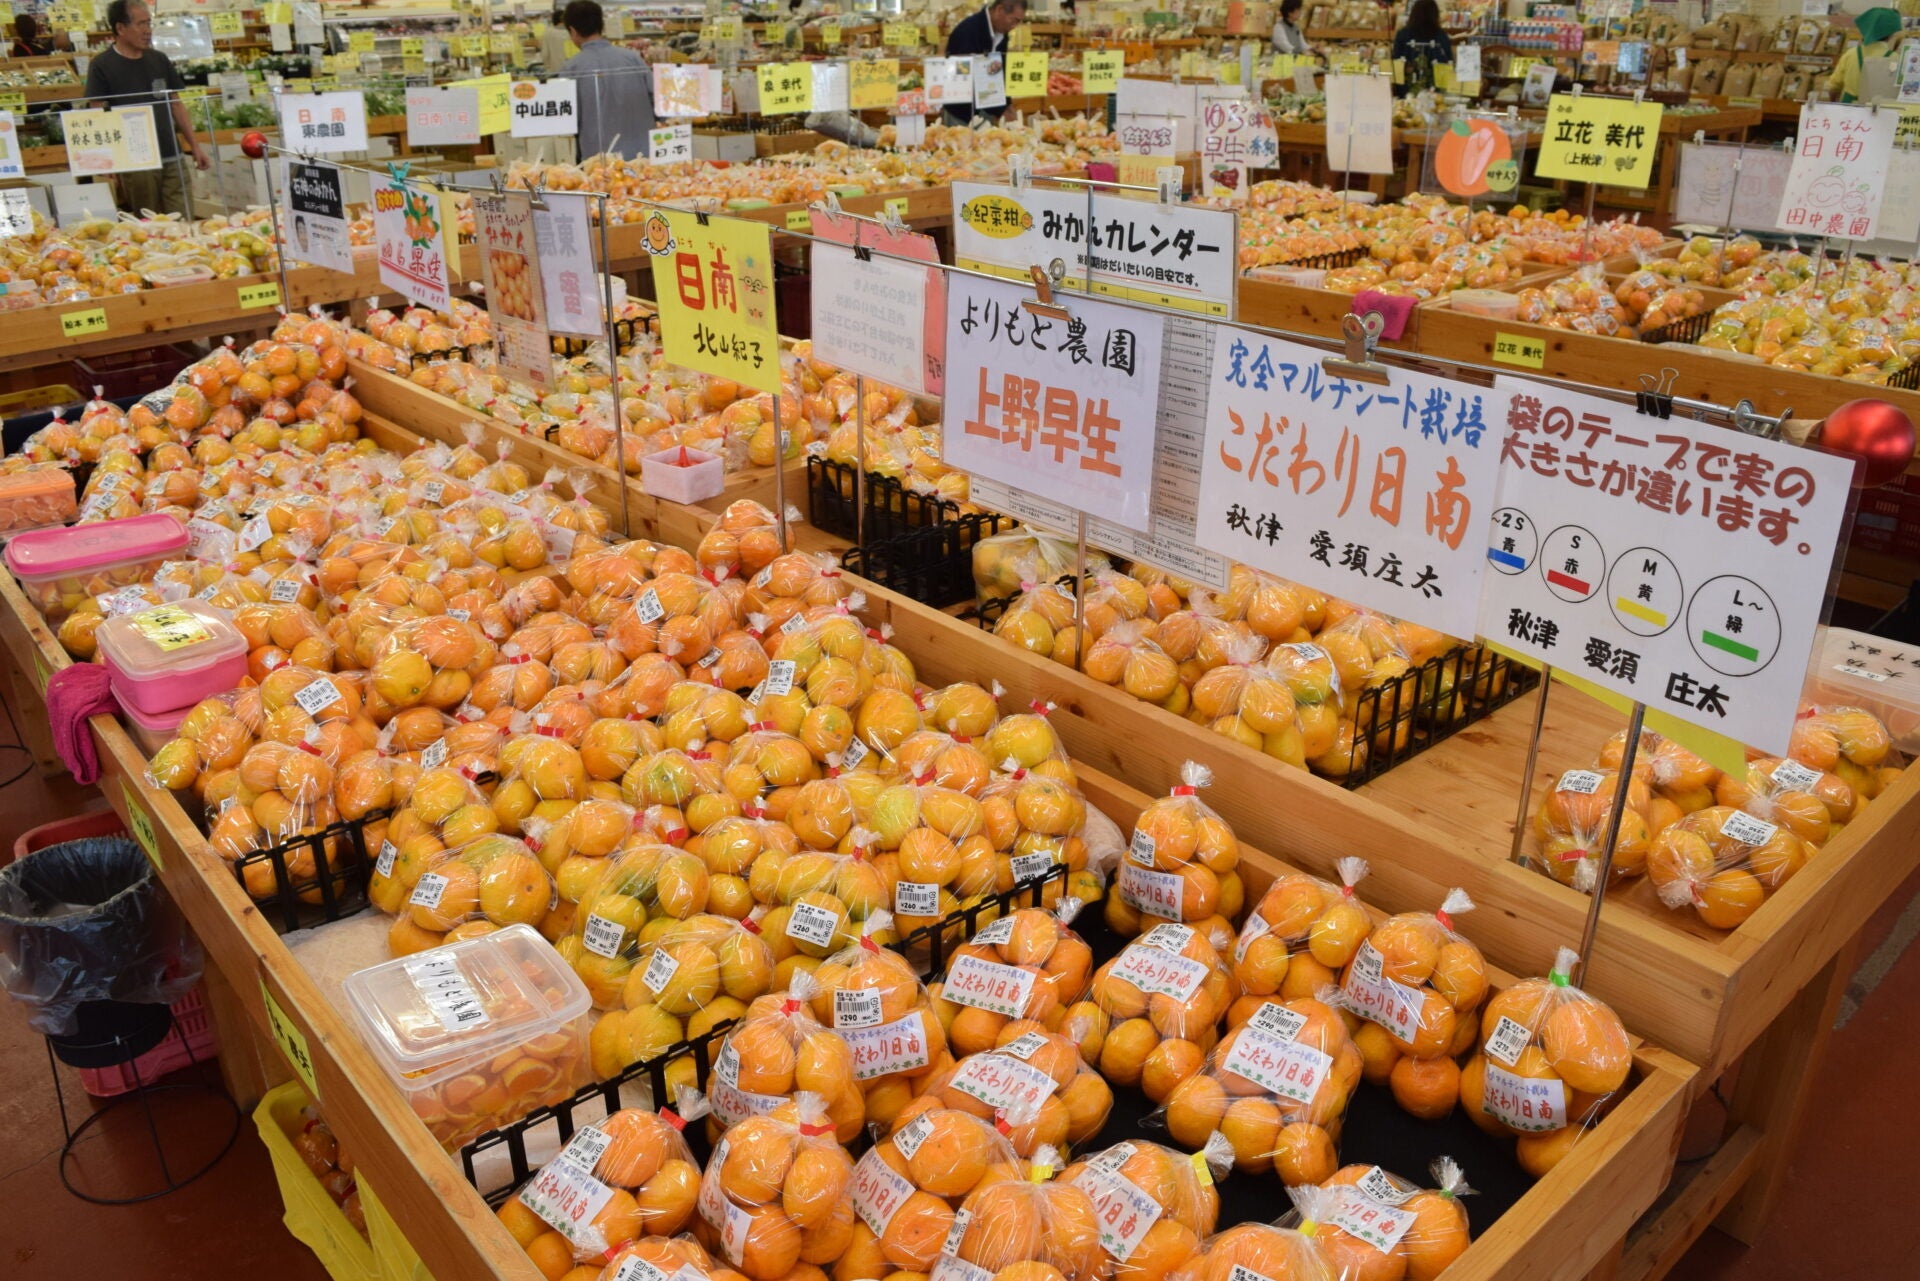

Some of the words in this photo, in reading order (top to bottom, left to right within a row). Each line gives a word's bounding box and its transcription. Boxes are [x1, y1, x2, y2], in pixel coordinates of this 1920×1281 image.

[298, 107, 346, 123] 日南
[515, 99, 573, 119] 中山昌尚
[301, 122, 345, 139] 東農園
[1554, 118, 1595, 145] 立花
[1604, 122, 1647, 151] 美代
[1204, 136, 1246, 164] 早生
[1801, 134, 1865, 163] 日南
[973, 203, 1021, 227] 紀菜柑
[1785, 207, 1872, 238] 田中農園
[1041, 209, 1220, 262] みかんカレンダー
[675, 247, 737, 314] 日南
[692, 322, 765, 369] 北山紀子
[960, 295, 1137, 377] よりもと農園
[1496, 341, 1518, 355] 立花
[964, 365, 1122, 478] 上野早生
[1505, 392, 1816, 508] 袋のテープで実の
[1219, 404, 1472, 551] こだわり日南
[1500, 430, 1812, 556] 大きさが違います。
[1225, 503, 1284, 546] 秋津
[1502, 536, 1516, 554] 青
[1570, 534, 1582, 550] S
[1564, 558, 1580, 575] 赤
[1642, 558, 1658, 576] M
[1637, 583, 1653, 602] 黄
[1725, 614, 1744, 635] 緑
[1507, 607, 1561, 650] 秋津
[1582, 635, 1641, 685] 愛須
[1663, 671, 1730, 719] 庄太
[901, 902, 916, 910] ¥260
[793, 924, 810, 934] ¥260
[1122, 951, 1192, 989] こだわり日南
[952, 971, 1021, 1002] こだわり日南
[840, 1014, 858, 1022] ¥290
[1257, 1020, 1275, 1030] ¥290
[853, 1035, 921, 1066] だわり日南
[1237, 1043, 1315, 1088] こだわり日南
[964, 1062, 1039, 1104] こだわり日南
